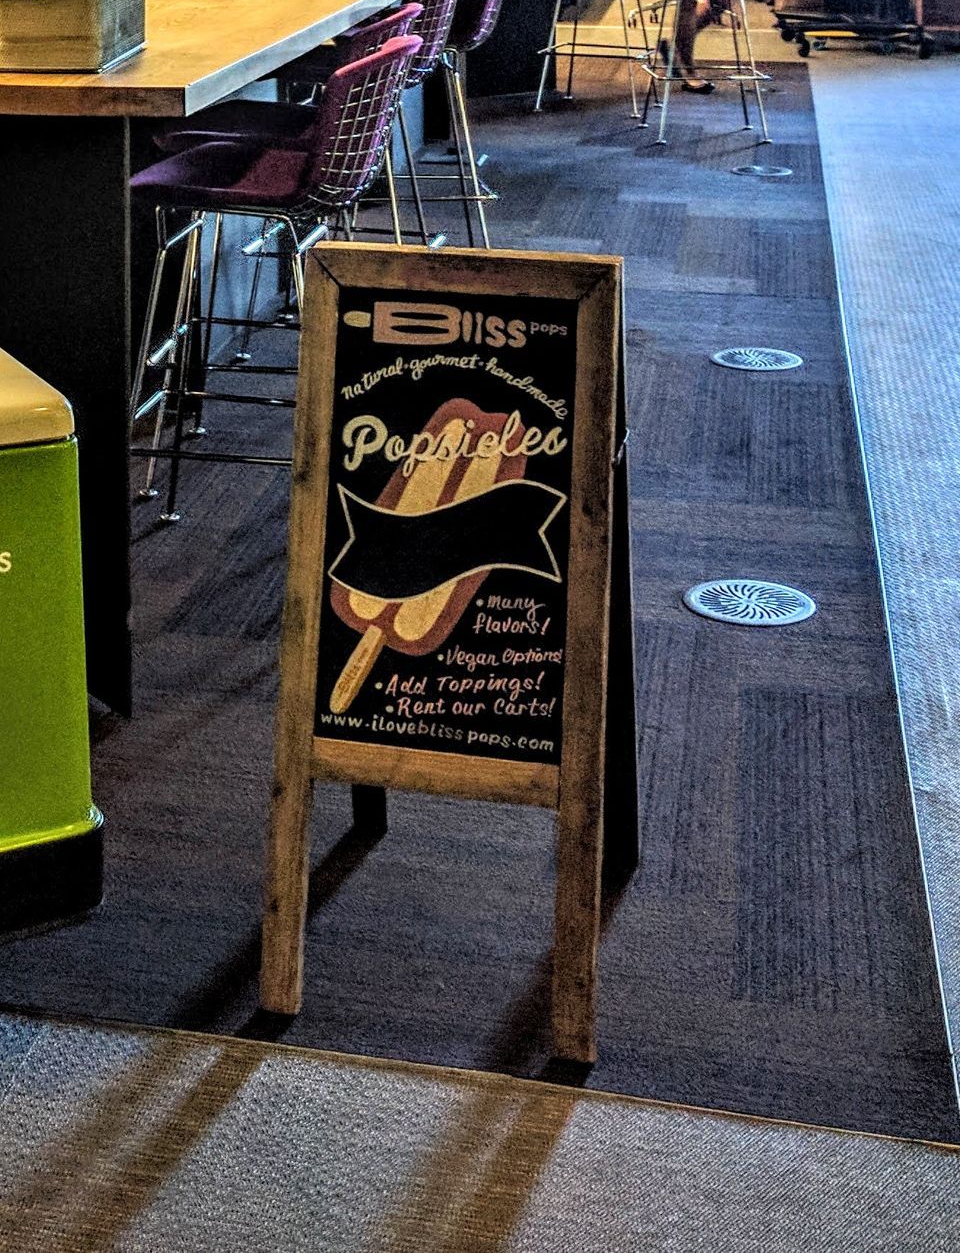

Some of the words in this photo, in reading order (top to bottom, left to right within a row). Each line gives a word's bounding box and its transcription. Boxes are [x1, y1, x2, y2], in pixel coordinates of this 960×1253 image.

[373, 301, 527, 348] Bliss
[530, 321, 568, 336] pops
[341, 357, 403, 400] natural
[409, 354, 480, 380] gourmet
[485, 357, 568, 420] handmade
[446, 644, 499, 672] Vegan
[385, 673, 428, 696] Add
[437, 671, 545, 701] Toppings!
[397, 697, 446, 718] Rent
[452, 701, 486, 716] our
[493, 697, 556, 718] Carts!
